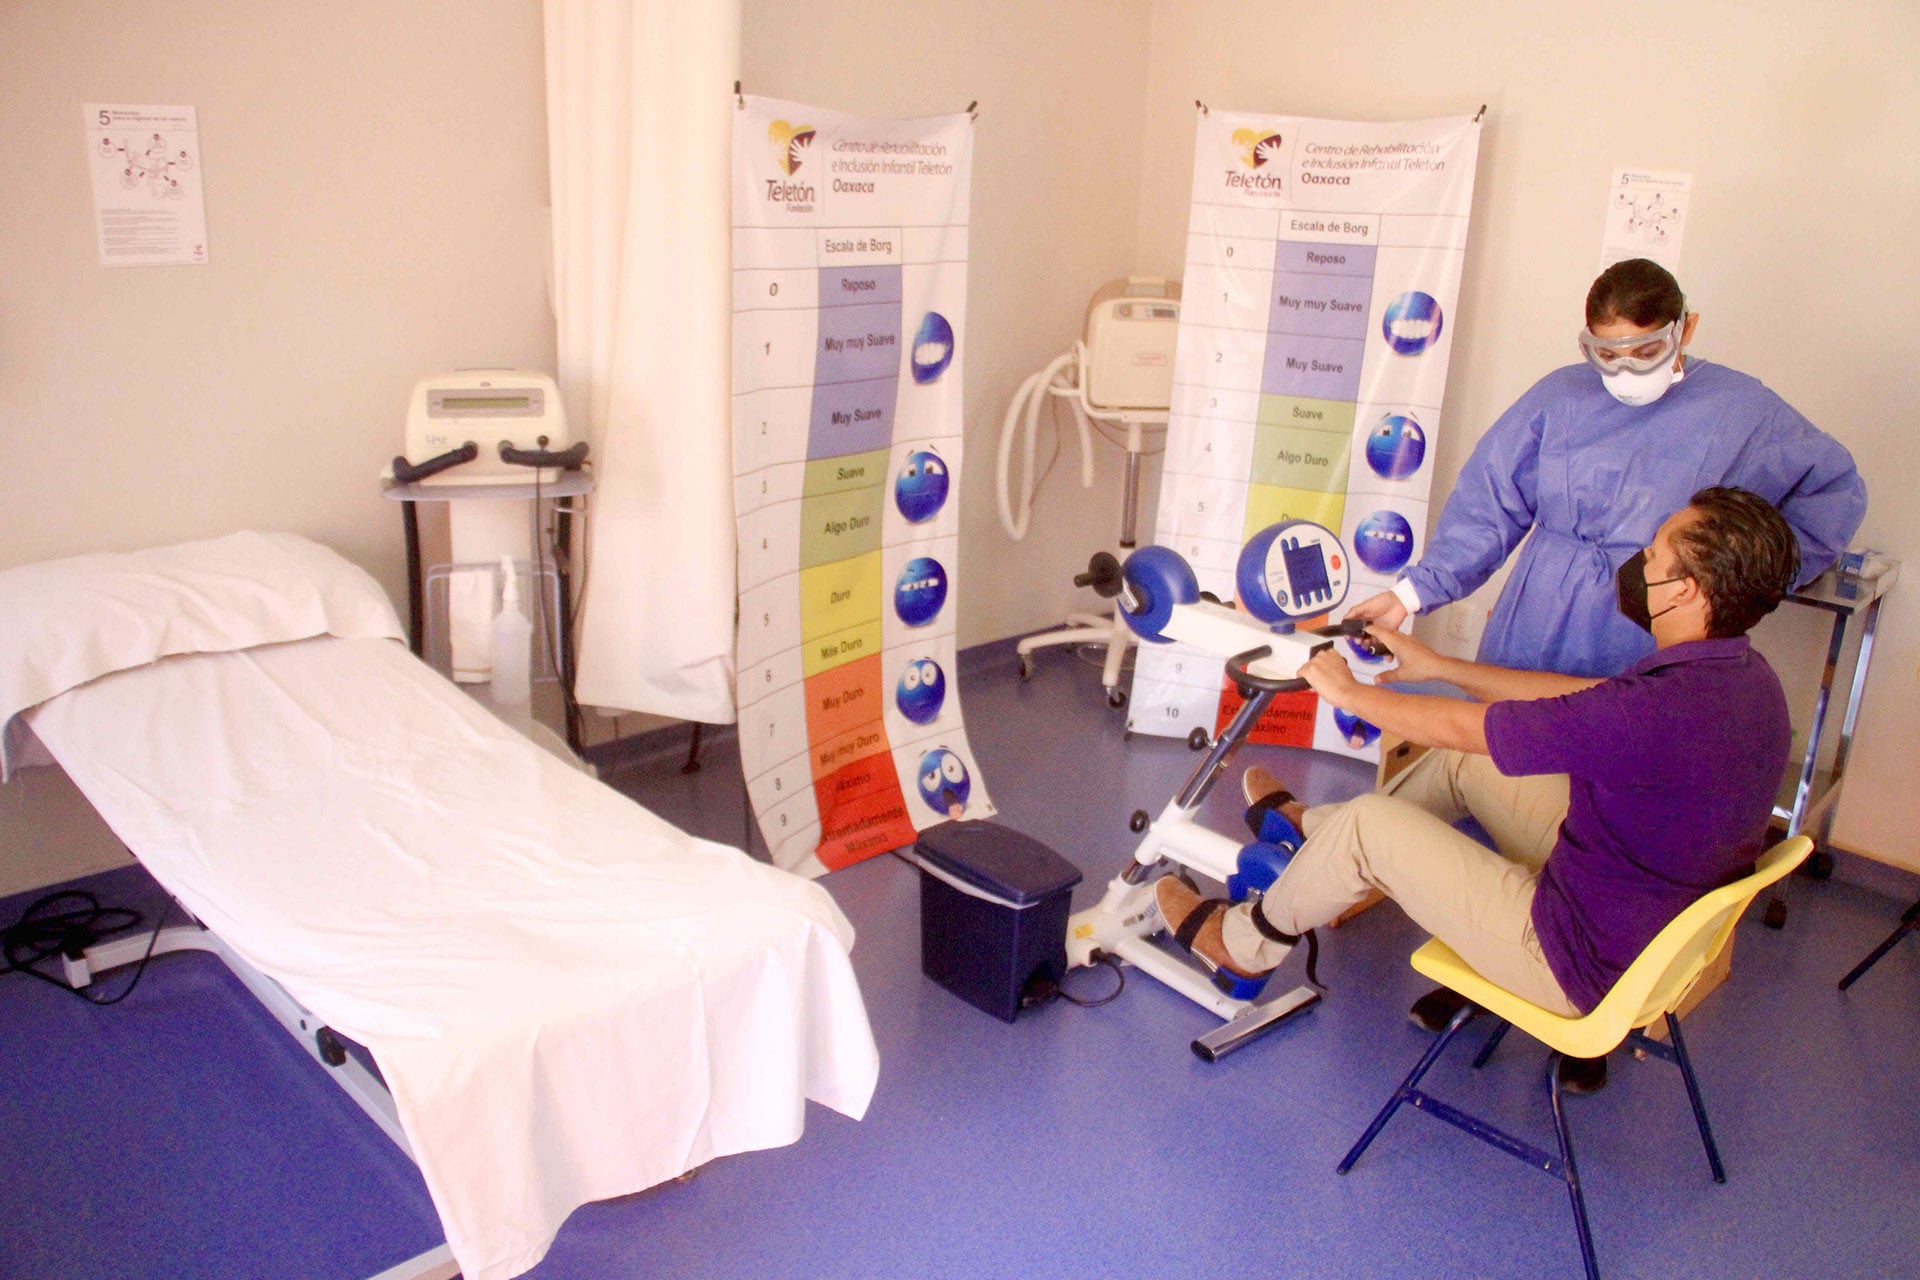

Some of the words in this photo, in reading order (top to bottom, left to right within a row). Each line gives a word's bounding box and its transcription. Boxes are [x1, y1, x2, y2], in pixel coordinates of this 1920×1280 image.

[99, 110, 111, 125] 5
[1305, 142, 1342, 156] Centro
[1344, 144, 1358, 156] de
[831, 161, 838, 172] e
[839, 158, 880, 174] Inclusión
[882, 160, 916, 175] Infantil
[918, 160, 953, 176] Teletón
[1302, 160, 1310, 169] e
[1310, 158, 1359, 171] Inclusión
[832, 179, 875, 193] Oaxaca
[1225, 170, 1281, 190] Teletón
[1301, 172, 1350, 186] Oaxaca
[1621, 173, 1629, 185] 5
[766, 179, 815, 203] Teletón
[1290, 219, 1325, 233] Escala
[1327, 220, 1340, 233] de
[1343, 222, 1369, 237] Borg
[825, 239, 854, 253] Escala
[856, 240, 867, 252] de
[870, 239, 892, 255] Borg
[1226, 246, 1234, 258] 0
[1306, 251, 1346, 266] Reposo
[769, 282, 778, 297] 0
[841, 278, 876, 293] Reposo
[1223, 292, 1229, 303] 1
[1279, 295, 1301, 311] Muy
[1304, 299, 1327, 313] muy
[1330, 299, 1363, 313] Suave
[764, 342, 771, 355] 1
[825, 337, 844, 353] Muy
[846, 337, 865, 351] muy
[867, 333, 896, 348] Suave
[1215, 352, 1224, 364] 2
[1286, 357, 1308, 372] Muy
[1311, 359, 1344, 374] Suave
[1210, 397, 1218, 409] 3
[831, 411, 852, 426] Muy
[854, 408, 882, 422] Suave
[1292, 406, 1324, 421] Suave
[1204, 441, 1212, 453] 4
[1277, 450, 1302, 464] Algo
[1304, 453, 1329, 467] Duro
[837, 466, 865, 481] Suave
[1197, 501, 1205, 513] 5
[824, 519, 847, 536] Algo
[850, 515, 870, 531] Duro
[1191, 546, 1199, 558] 6
[830, 589, 851, 604] Duro
[764, 613, 769, 627] 5
[840, 639, 863, 654] Duro
[765, 669, 771, 683] 6
[1175, 662, 1183, 675] 9
[822, 695, 841, 711] Muy
[843, 687, 864, 703] Duro
[1165, 706, 1180, 719] 10
[857, 733, 880, 749] Duro
[775, 777, 782, 791] 8
[780, 813, 787, 827] 9
